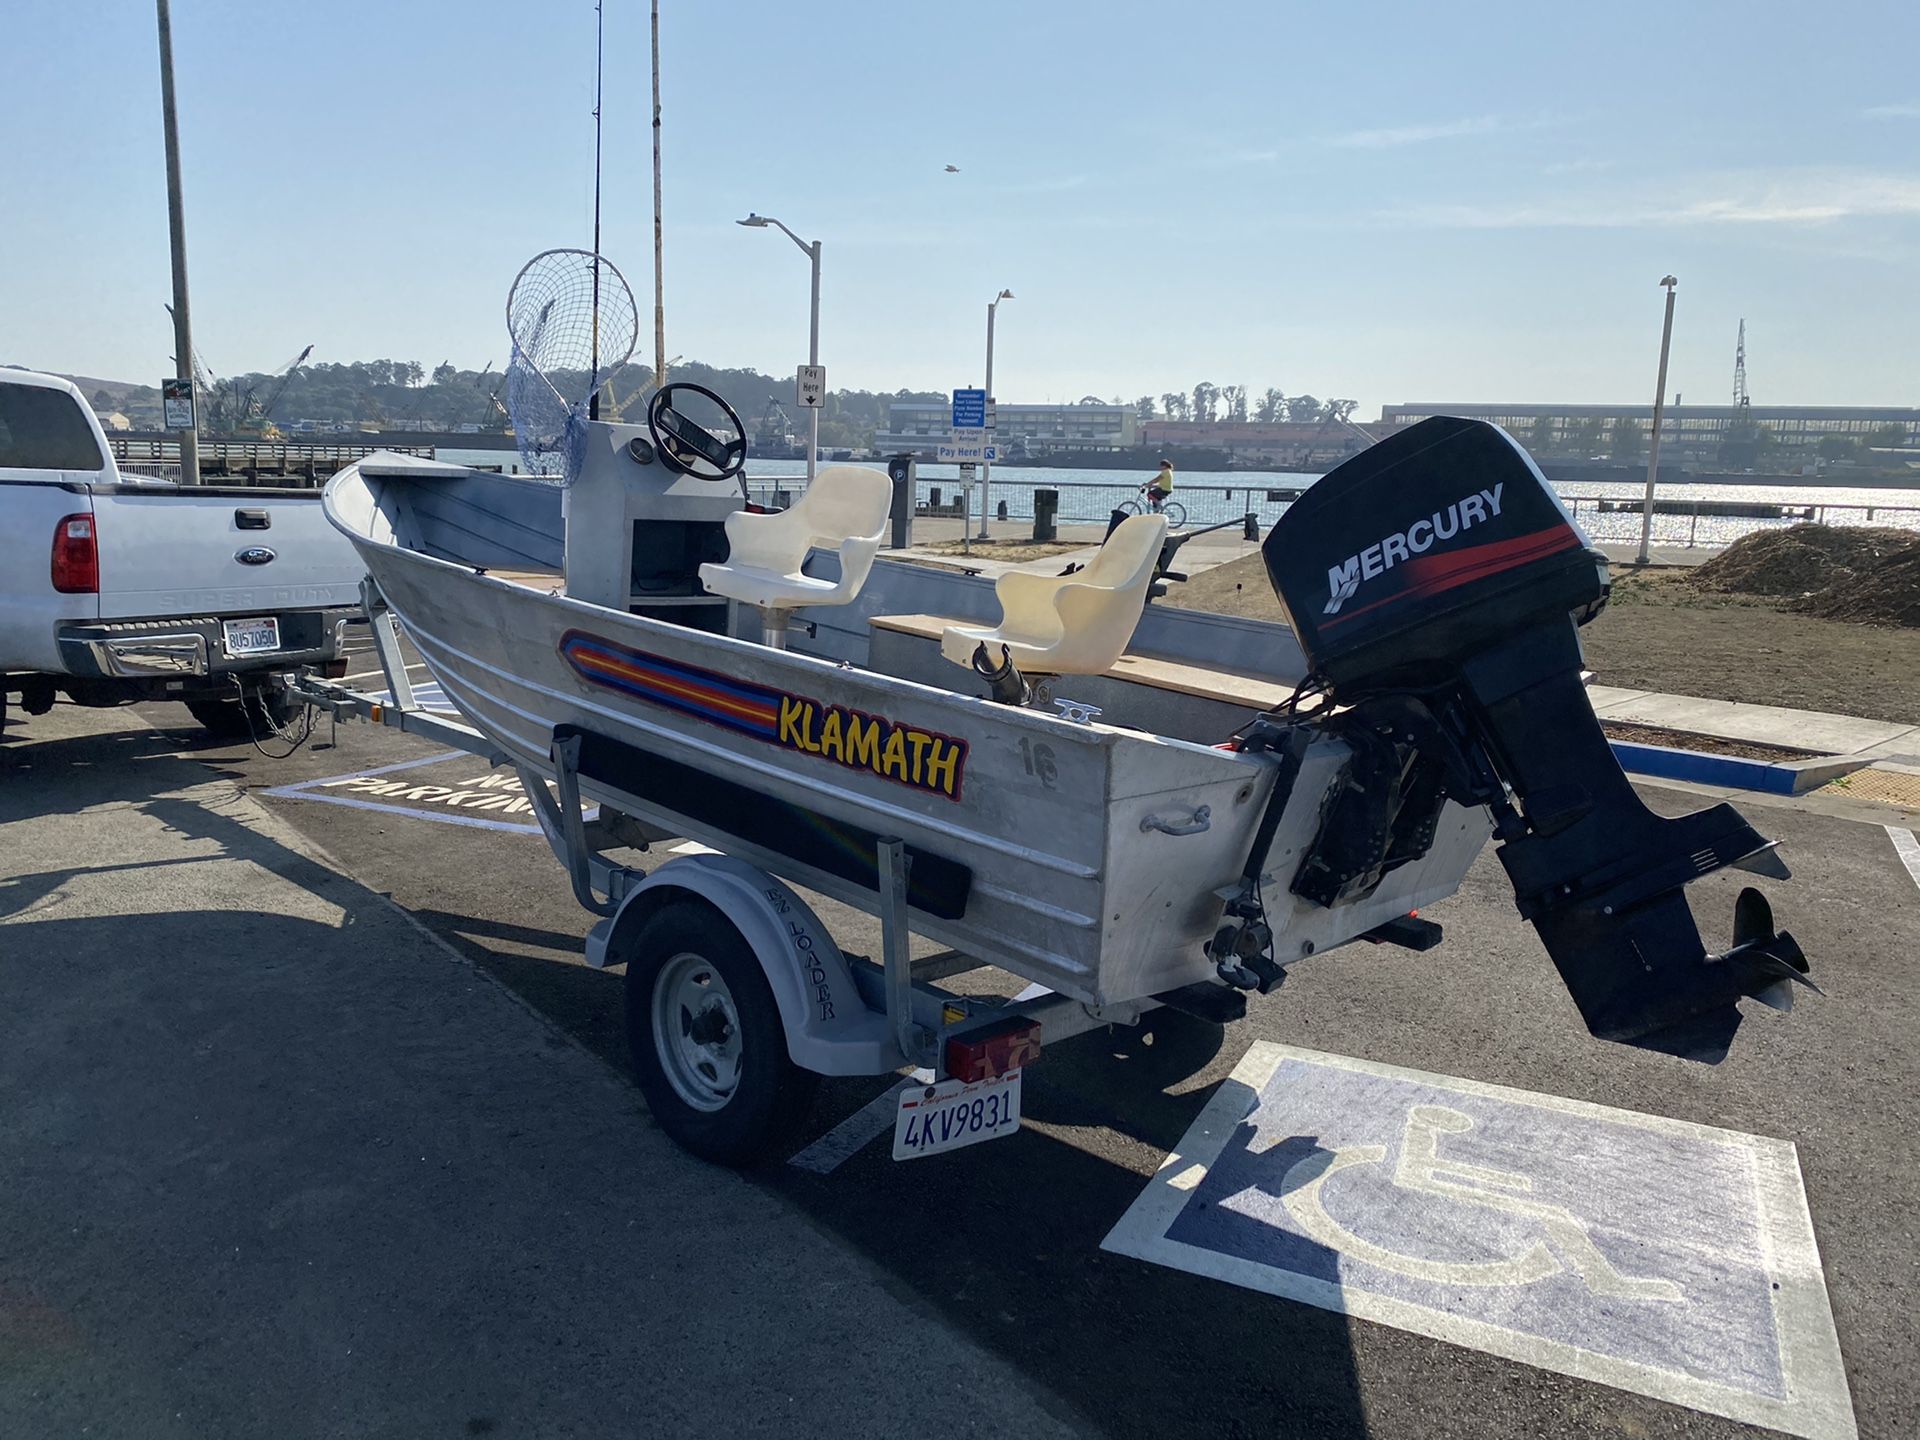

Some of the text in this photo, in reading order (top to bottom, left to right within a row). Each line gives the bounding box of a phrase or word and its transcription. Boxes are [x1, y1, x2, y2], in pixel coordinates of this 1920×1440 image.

[804, 367, 818, 379] Pay
[803, 382, 819, 392] Here
[940, 447, 981, 457] Pay Here!
[1323, 482, 1503, 614] MERCURY
[159, 588, 335, 609] SUPER DUTY
[230, 630, 275, 648] 8U57050
[780, 696, 960, 794] KLAMATH
[789, 921, 836, 1021] LOADER
[920, 1092, 958, 1106] California
[904, 1090, 1012, 1147] 4KV9831
